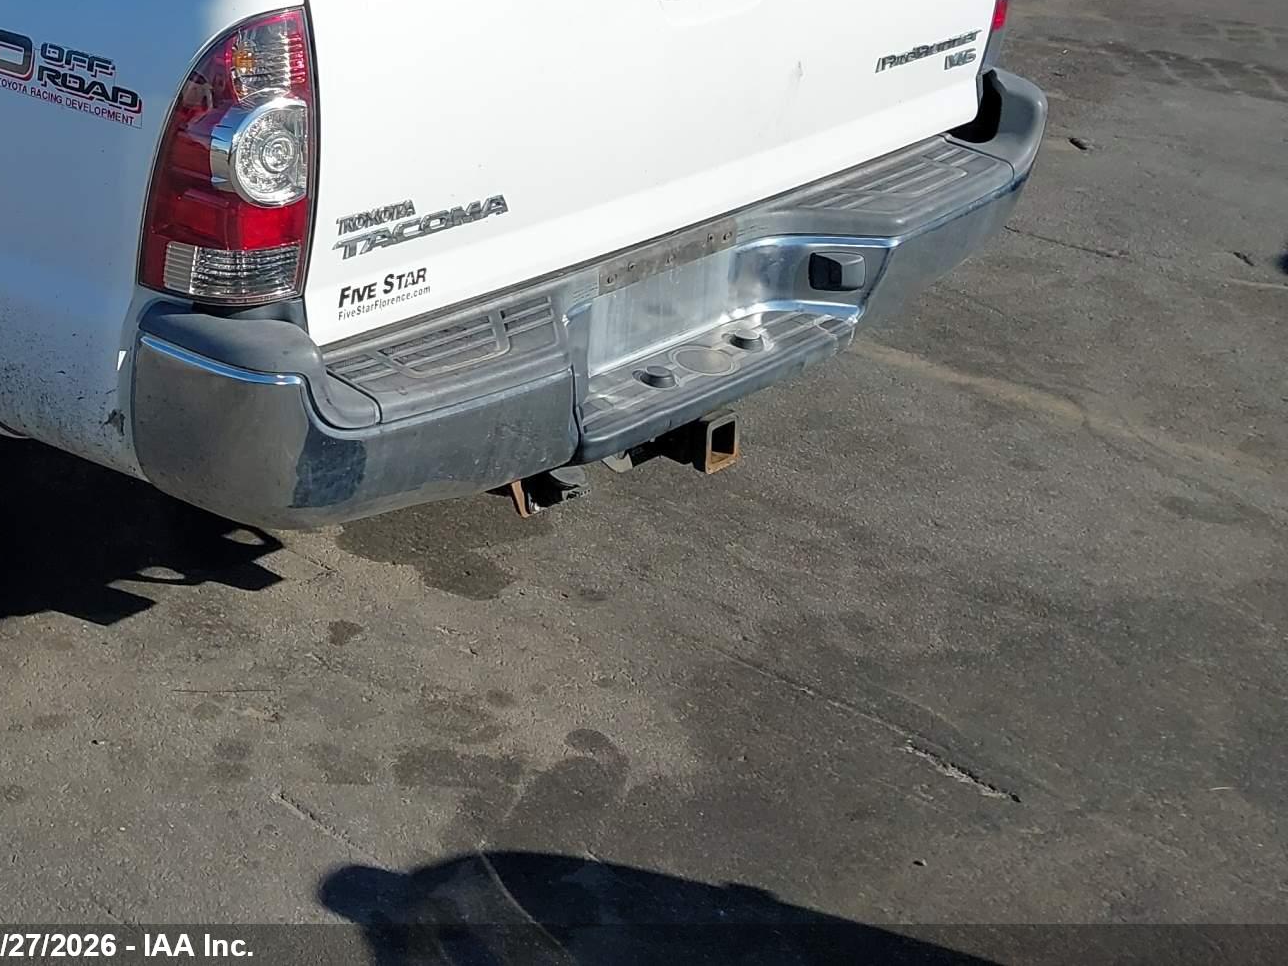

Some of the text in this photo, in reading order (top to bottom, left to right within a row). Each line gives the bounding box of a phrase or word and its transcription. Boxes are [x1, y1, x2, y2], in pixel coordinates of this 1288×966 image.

[40, 42, 116, 77] OFF
[944, 47, 977, 71] V6
[29, 85, 63, 105] RACING
[65, 96, 137, 126] DEVELOPMENT
[37, 65, 143, 114] ROAD
[332, 194, 509, 260] TACOMA
[336, 199, 416, 236] TOYOTA
[337, 286, 431, 321] FiveStarFlorence.com
[338, 267, 428, 308] FIVE STAR
